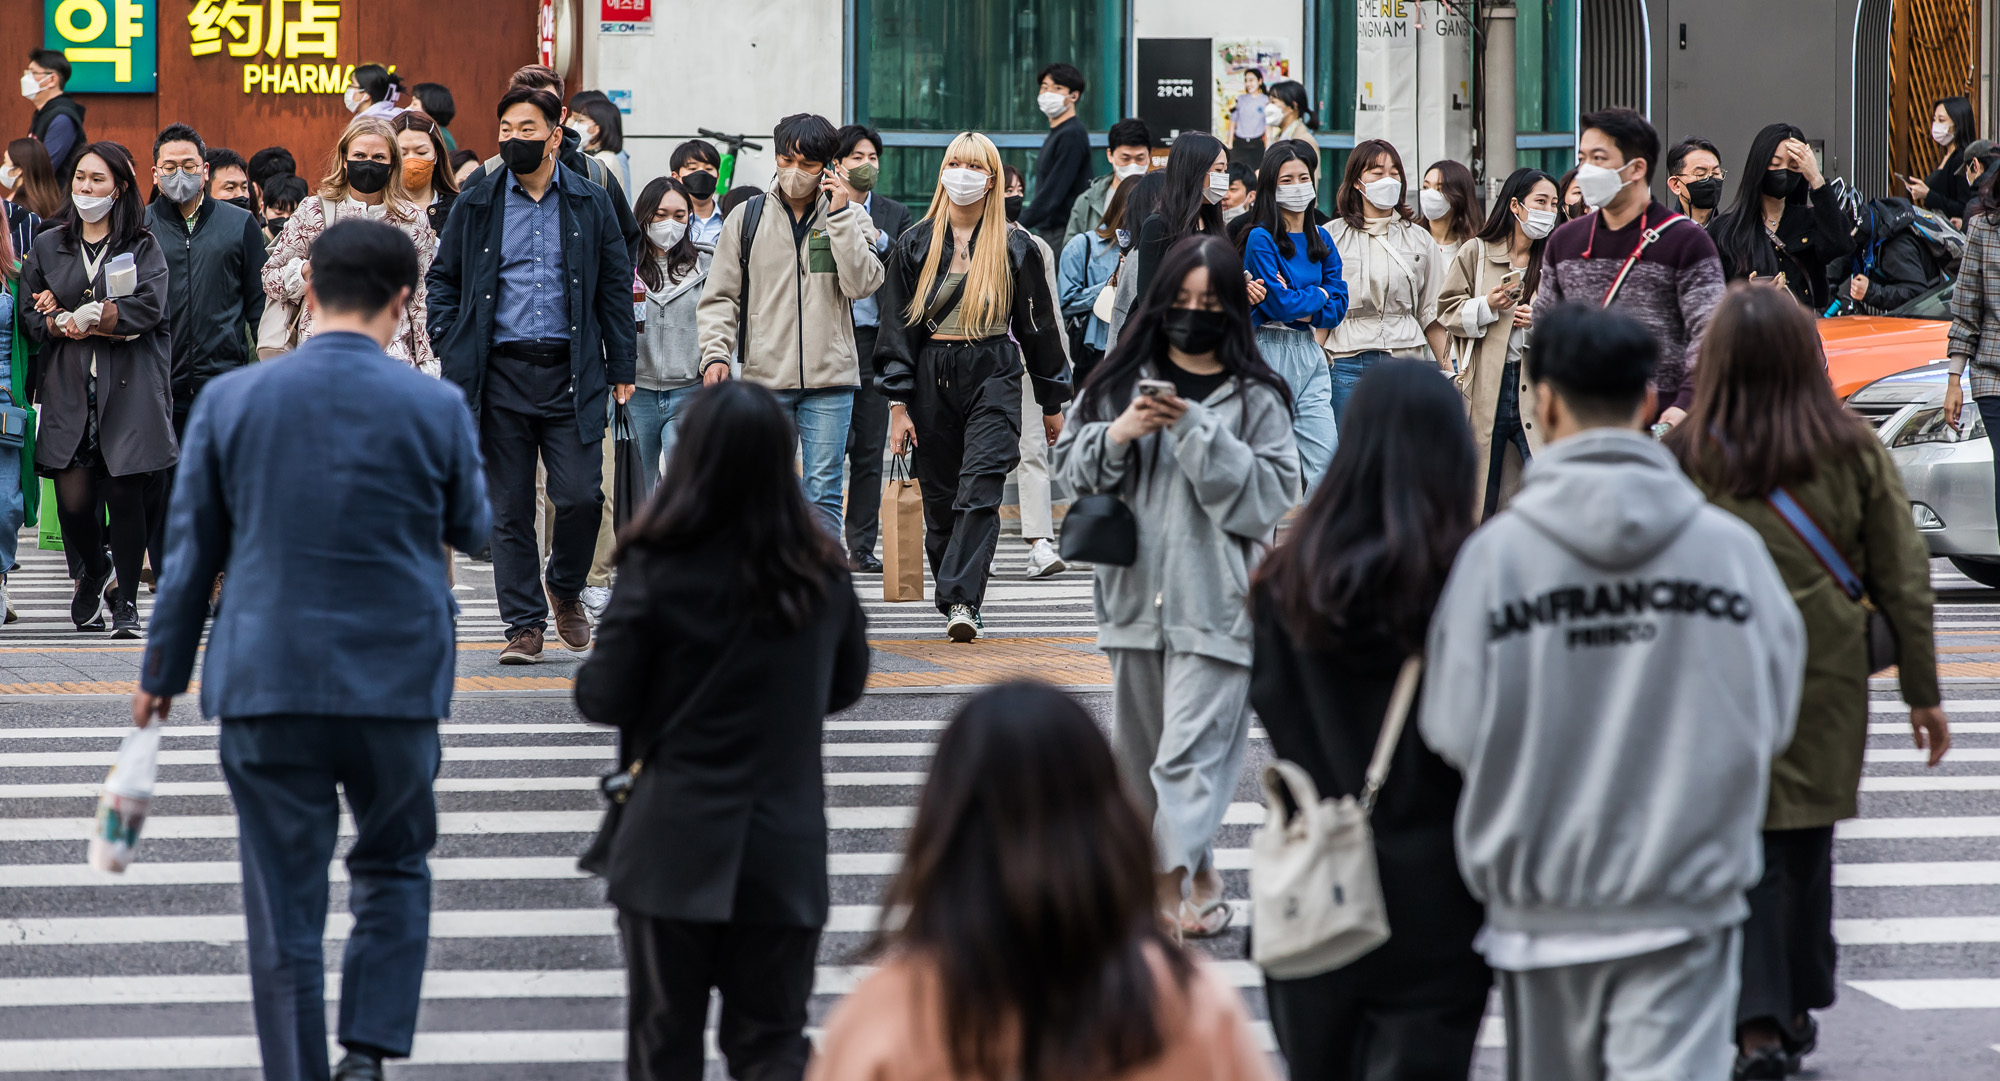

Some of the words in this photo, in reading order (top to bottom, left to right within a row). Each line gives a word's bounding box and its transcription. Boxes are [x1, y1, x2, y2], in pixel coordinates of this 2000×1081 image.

[54, 0, 143, 82] 약
[187, 0, 341, 58] 药店
[600, 23, 635, 32] SECOM
[243, 64, 396, 94] PHARMA
[1157, 86, 1193, 97] 29CM
